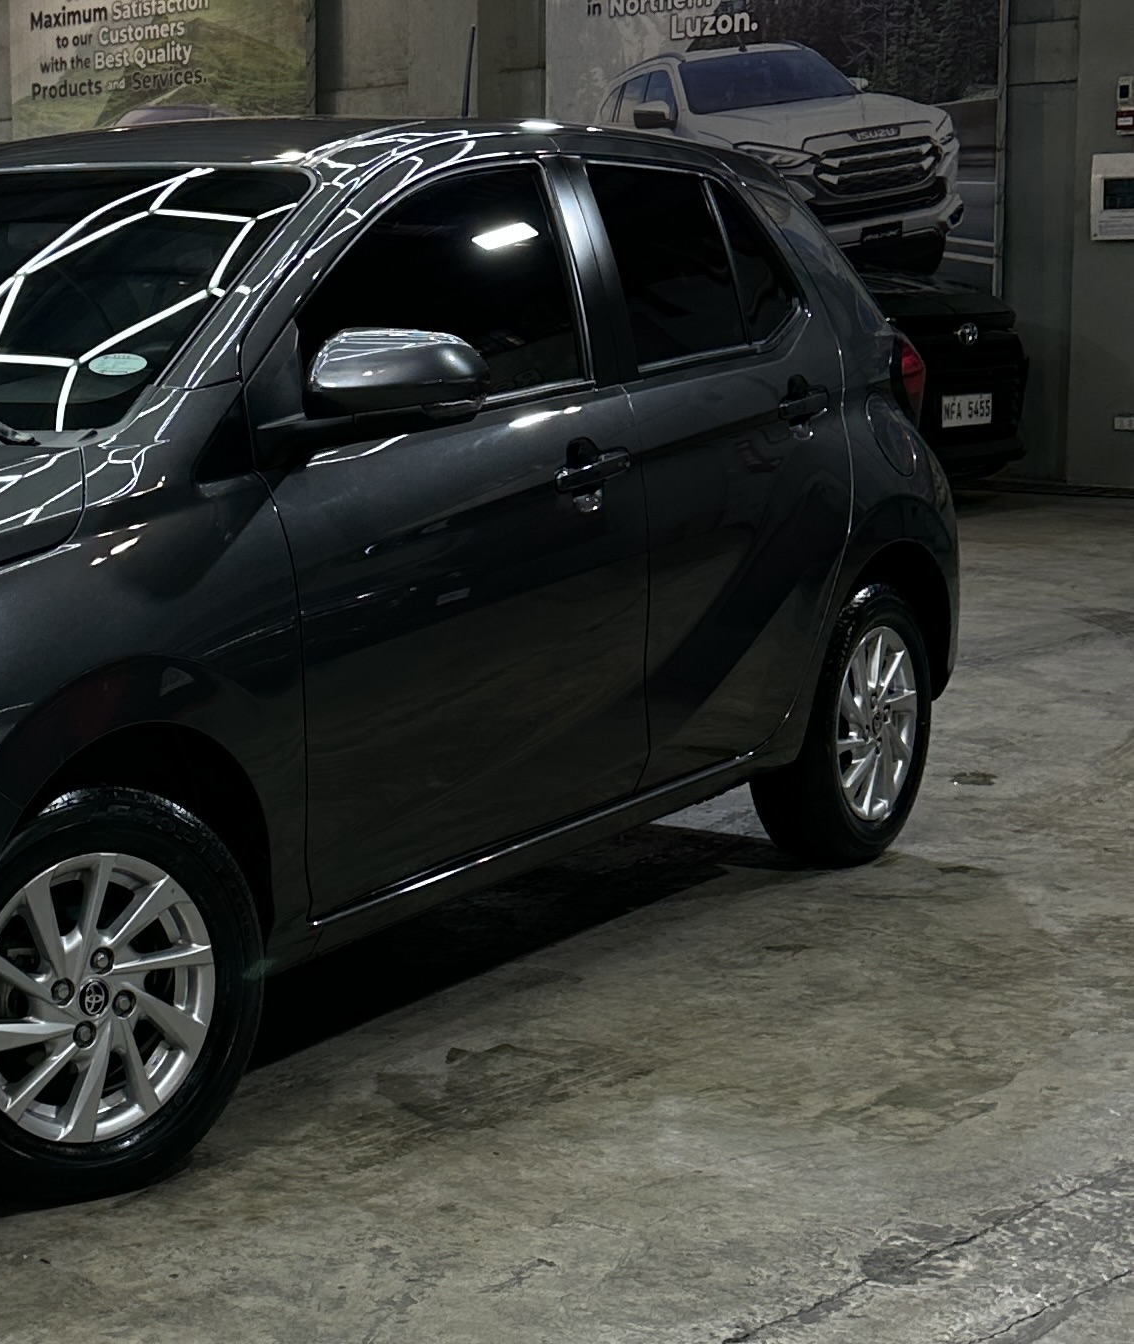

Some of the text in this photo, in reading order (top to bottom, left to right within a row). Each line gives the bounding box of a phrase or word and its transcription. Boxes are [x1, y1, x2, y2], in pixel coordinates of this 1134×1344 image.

[30, 6, 108, 32] Maximum
[670, 11, 759, 41] Luzon.
[56, 20, 185, 49] to our Customers
[40, 40, 193, 74] with the Best Quality
[32, 66, 207, 101] Products and Services.
[855, 127, 898, 141] ISUZU
